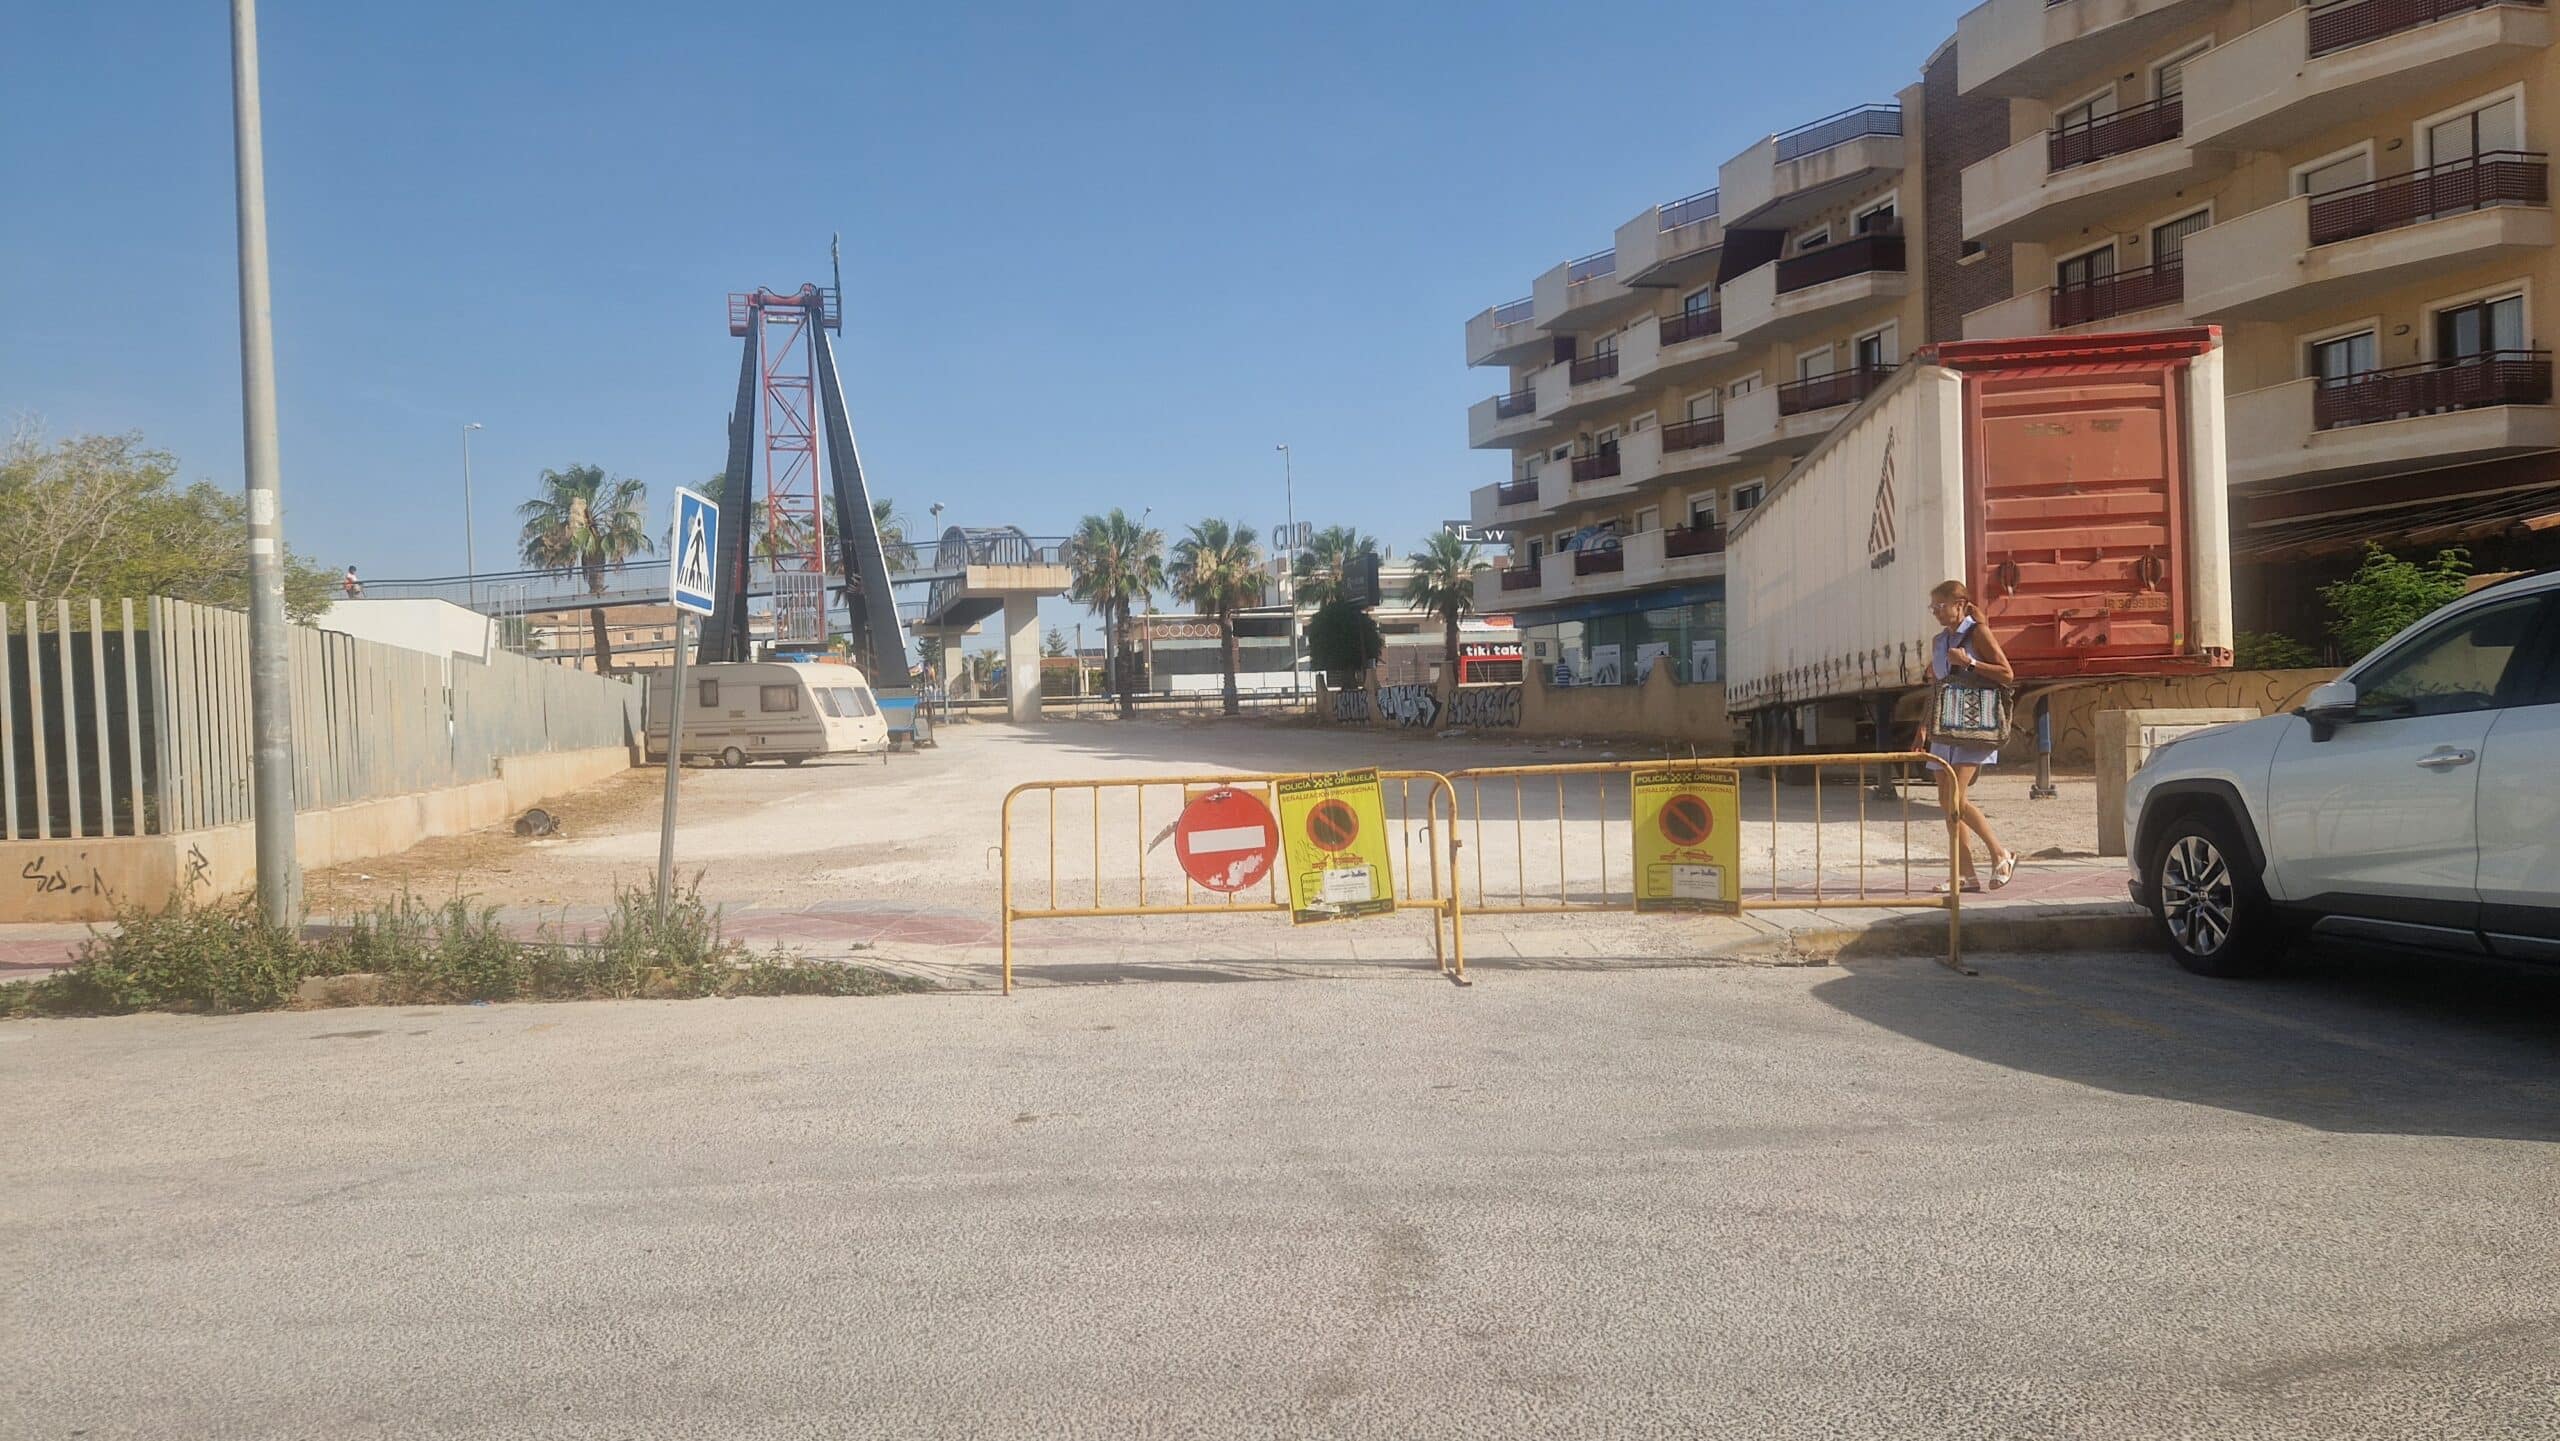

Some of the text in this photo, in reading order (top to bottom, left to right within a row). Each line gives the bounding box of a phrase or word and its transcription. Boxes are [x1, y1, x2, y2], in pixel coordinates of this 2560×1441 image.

[1272, 521, 1312, 551] CLUB
[1466, 644, 1490, 656] tiki
[1334, 773, 1375, 785] ORIHUELA
[1694, 774, 1734, 783] ORIHUELA
